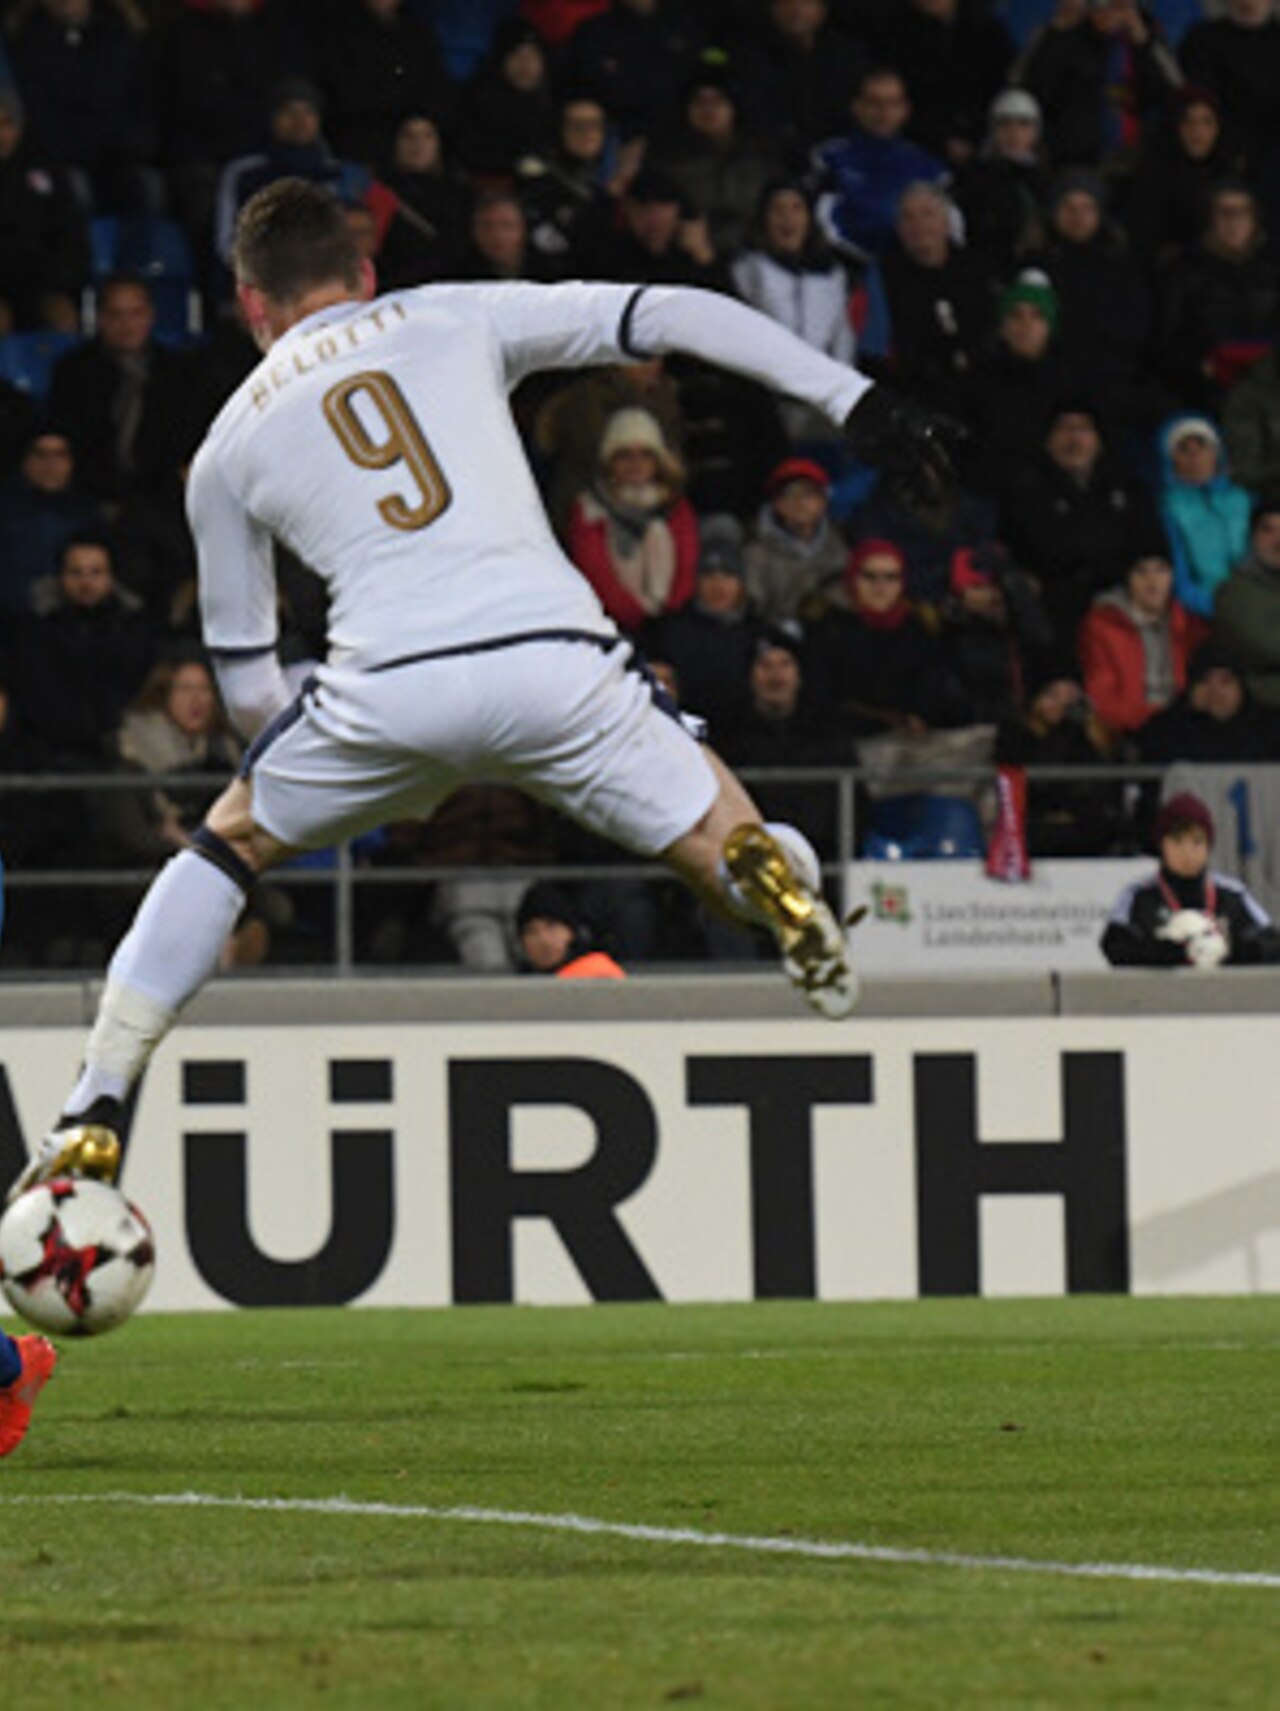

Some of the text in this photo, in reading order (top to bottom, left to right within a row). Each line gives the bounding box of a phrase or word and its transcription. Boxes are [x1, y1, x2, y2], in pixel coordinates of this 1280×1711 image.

[250, 302, 406, 412] BELOTTI
[322, 370, 454, 531] 9
[924, 926, 1065, 946] Landesbank
